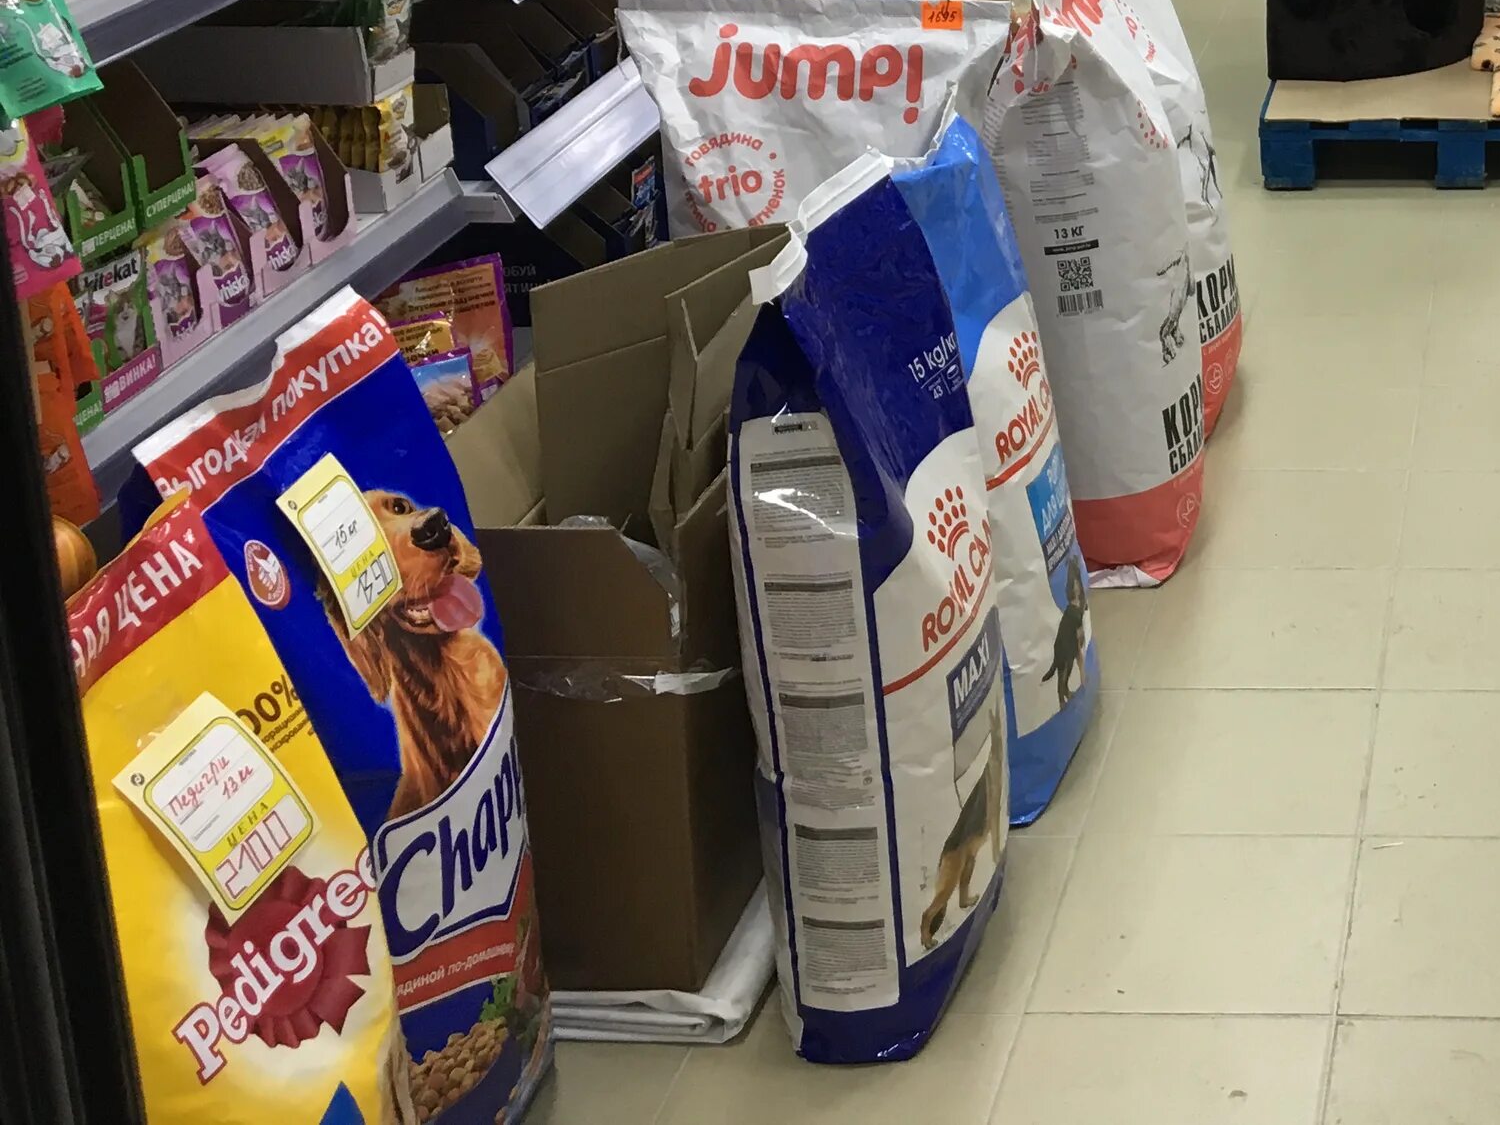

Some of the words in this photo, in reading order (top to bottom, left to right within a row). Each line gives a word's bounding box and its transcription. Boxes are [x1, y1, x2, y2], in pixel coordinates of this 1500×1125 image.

[688, 23, 924, 124] jump!
[684, 132, 764, 167] говядина
[699, 165, 763, 205] trio
[92, 218, 136, 249] ПЕРЦЕНА!
[995, 402, 1045, 465] ROYAL
[952, 632, 990, 703] MAXI
[242, 671, 301, 739] 00%
[221, 776, 239, 801] 13
[227, 800, 270, 849] ЦЕНА
